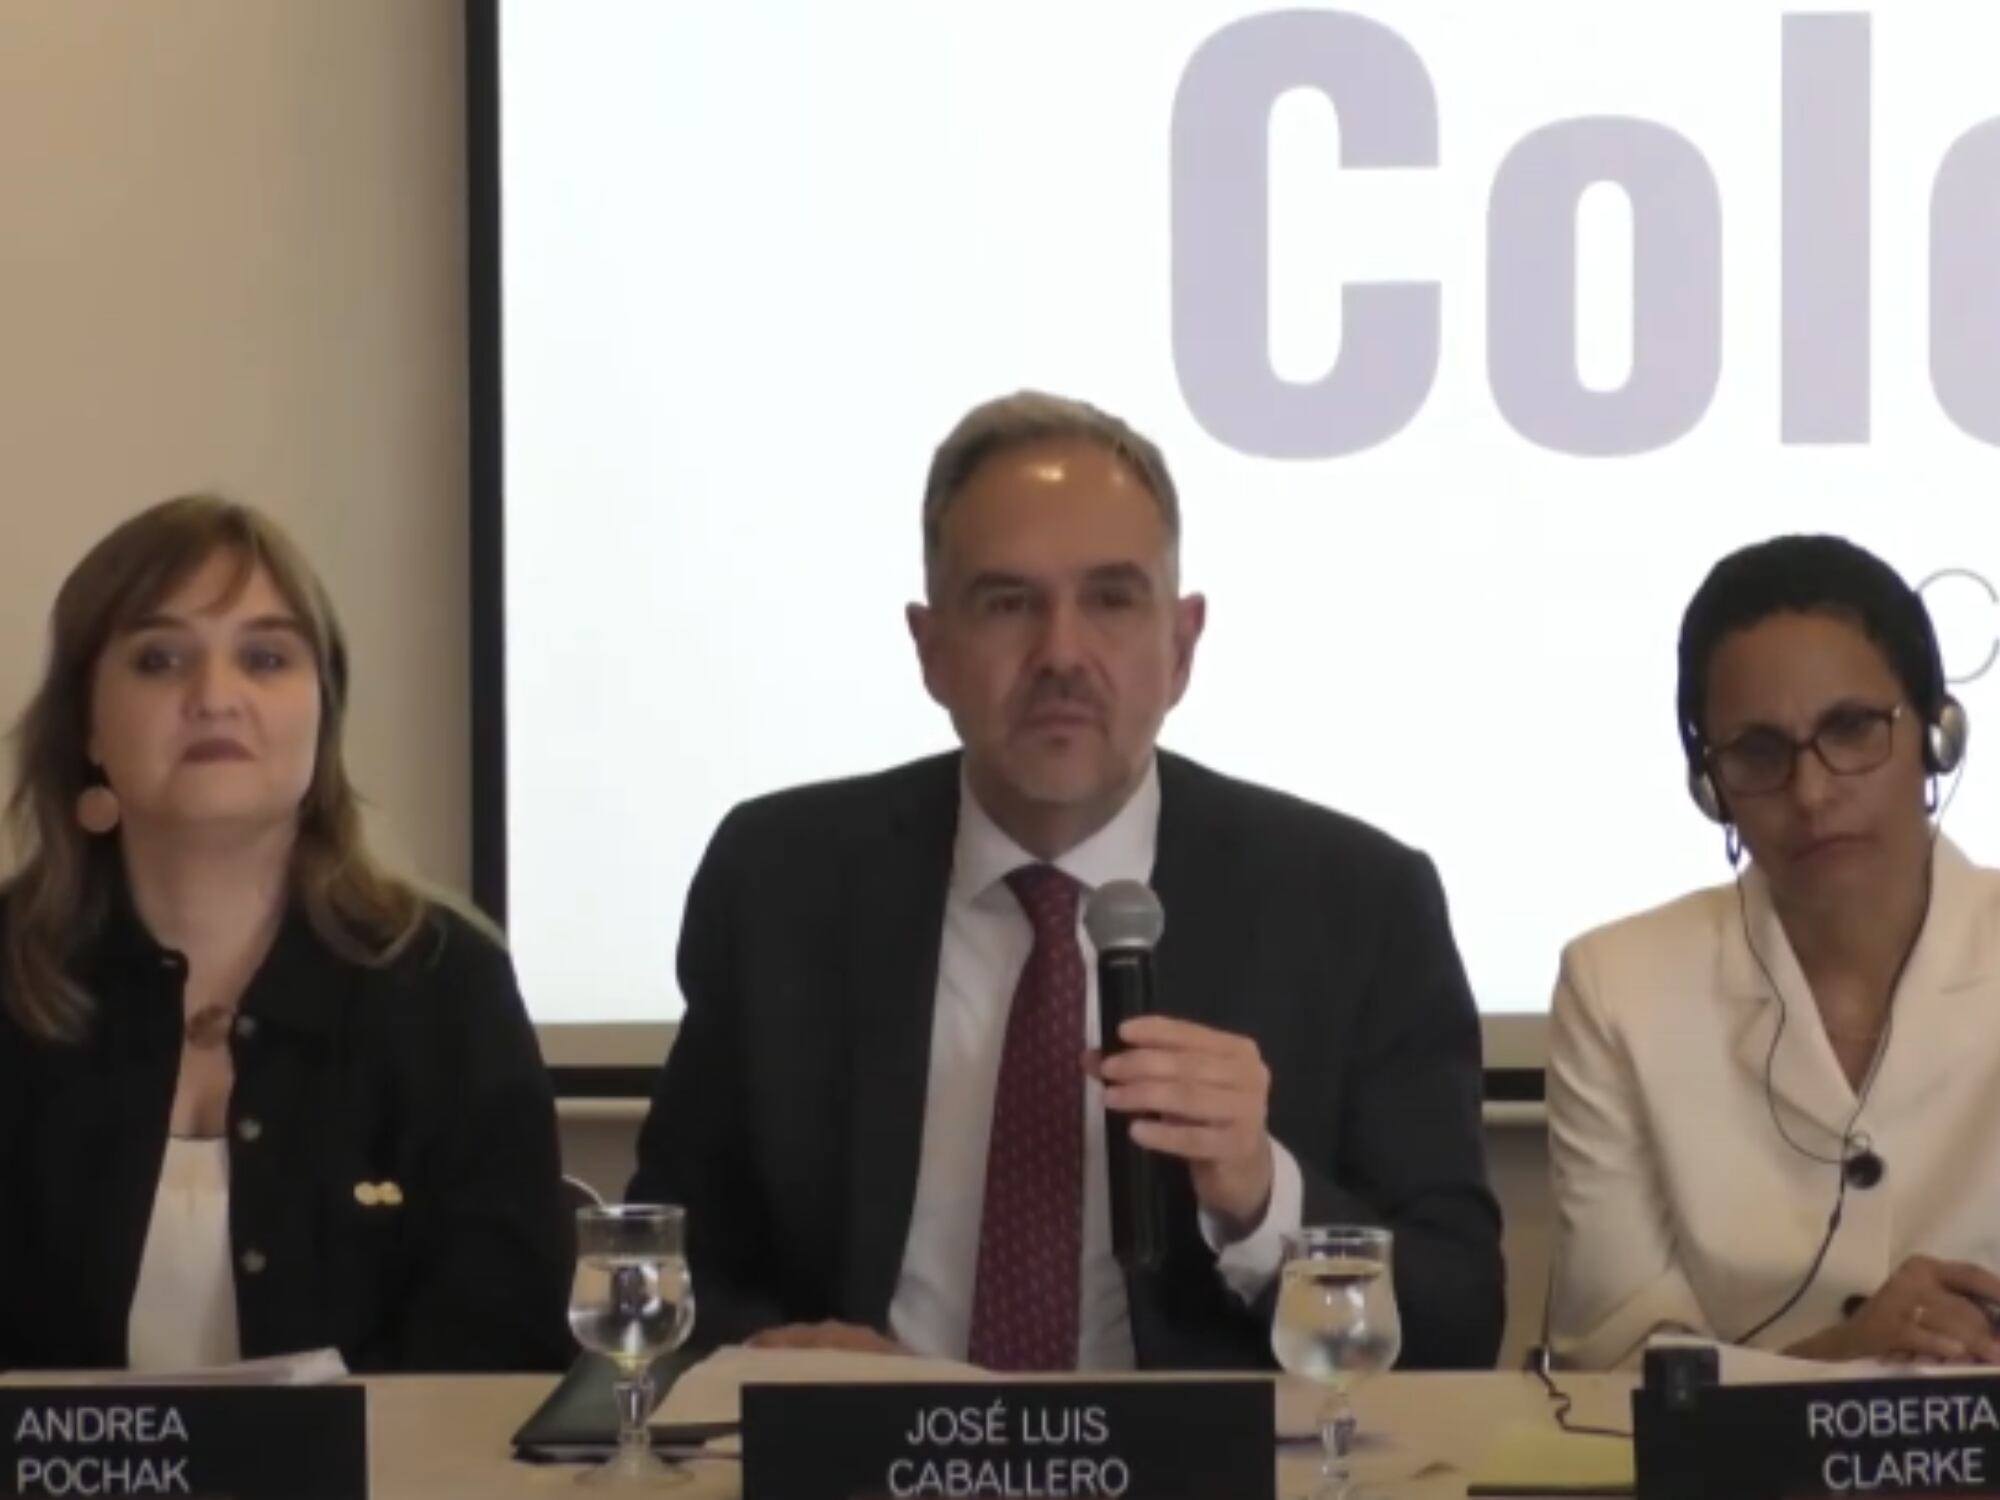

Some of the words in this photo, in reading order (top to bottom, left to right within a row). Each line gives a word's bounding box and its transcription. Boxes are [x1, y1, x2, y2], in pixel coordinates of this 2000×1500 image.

[16, 1407, 188, 1442] ANDREA
[907, 1400, 1006, 1445] JOSÉ
[1022, 1407, 1109, 1444] LUIS
[1807, 1396, 1999, 1438] ROBERTA
[18, 1458, 189, 1496] POCHAK
[888, 1458, 1129, 1498] CABALLERO
[1823, 1447, 1985, 1491] CLARKE
